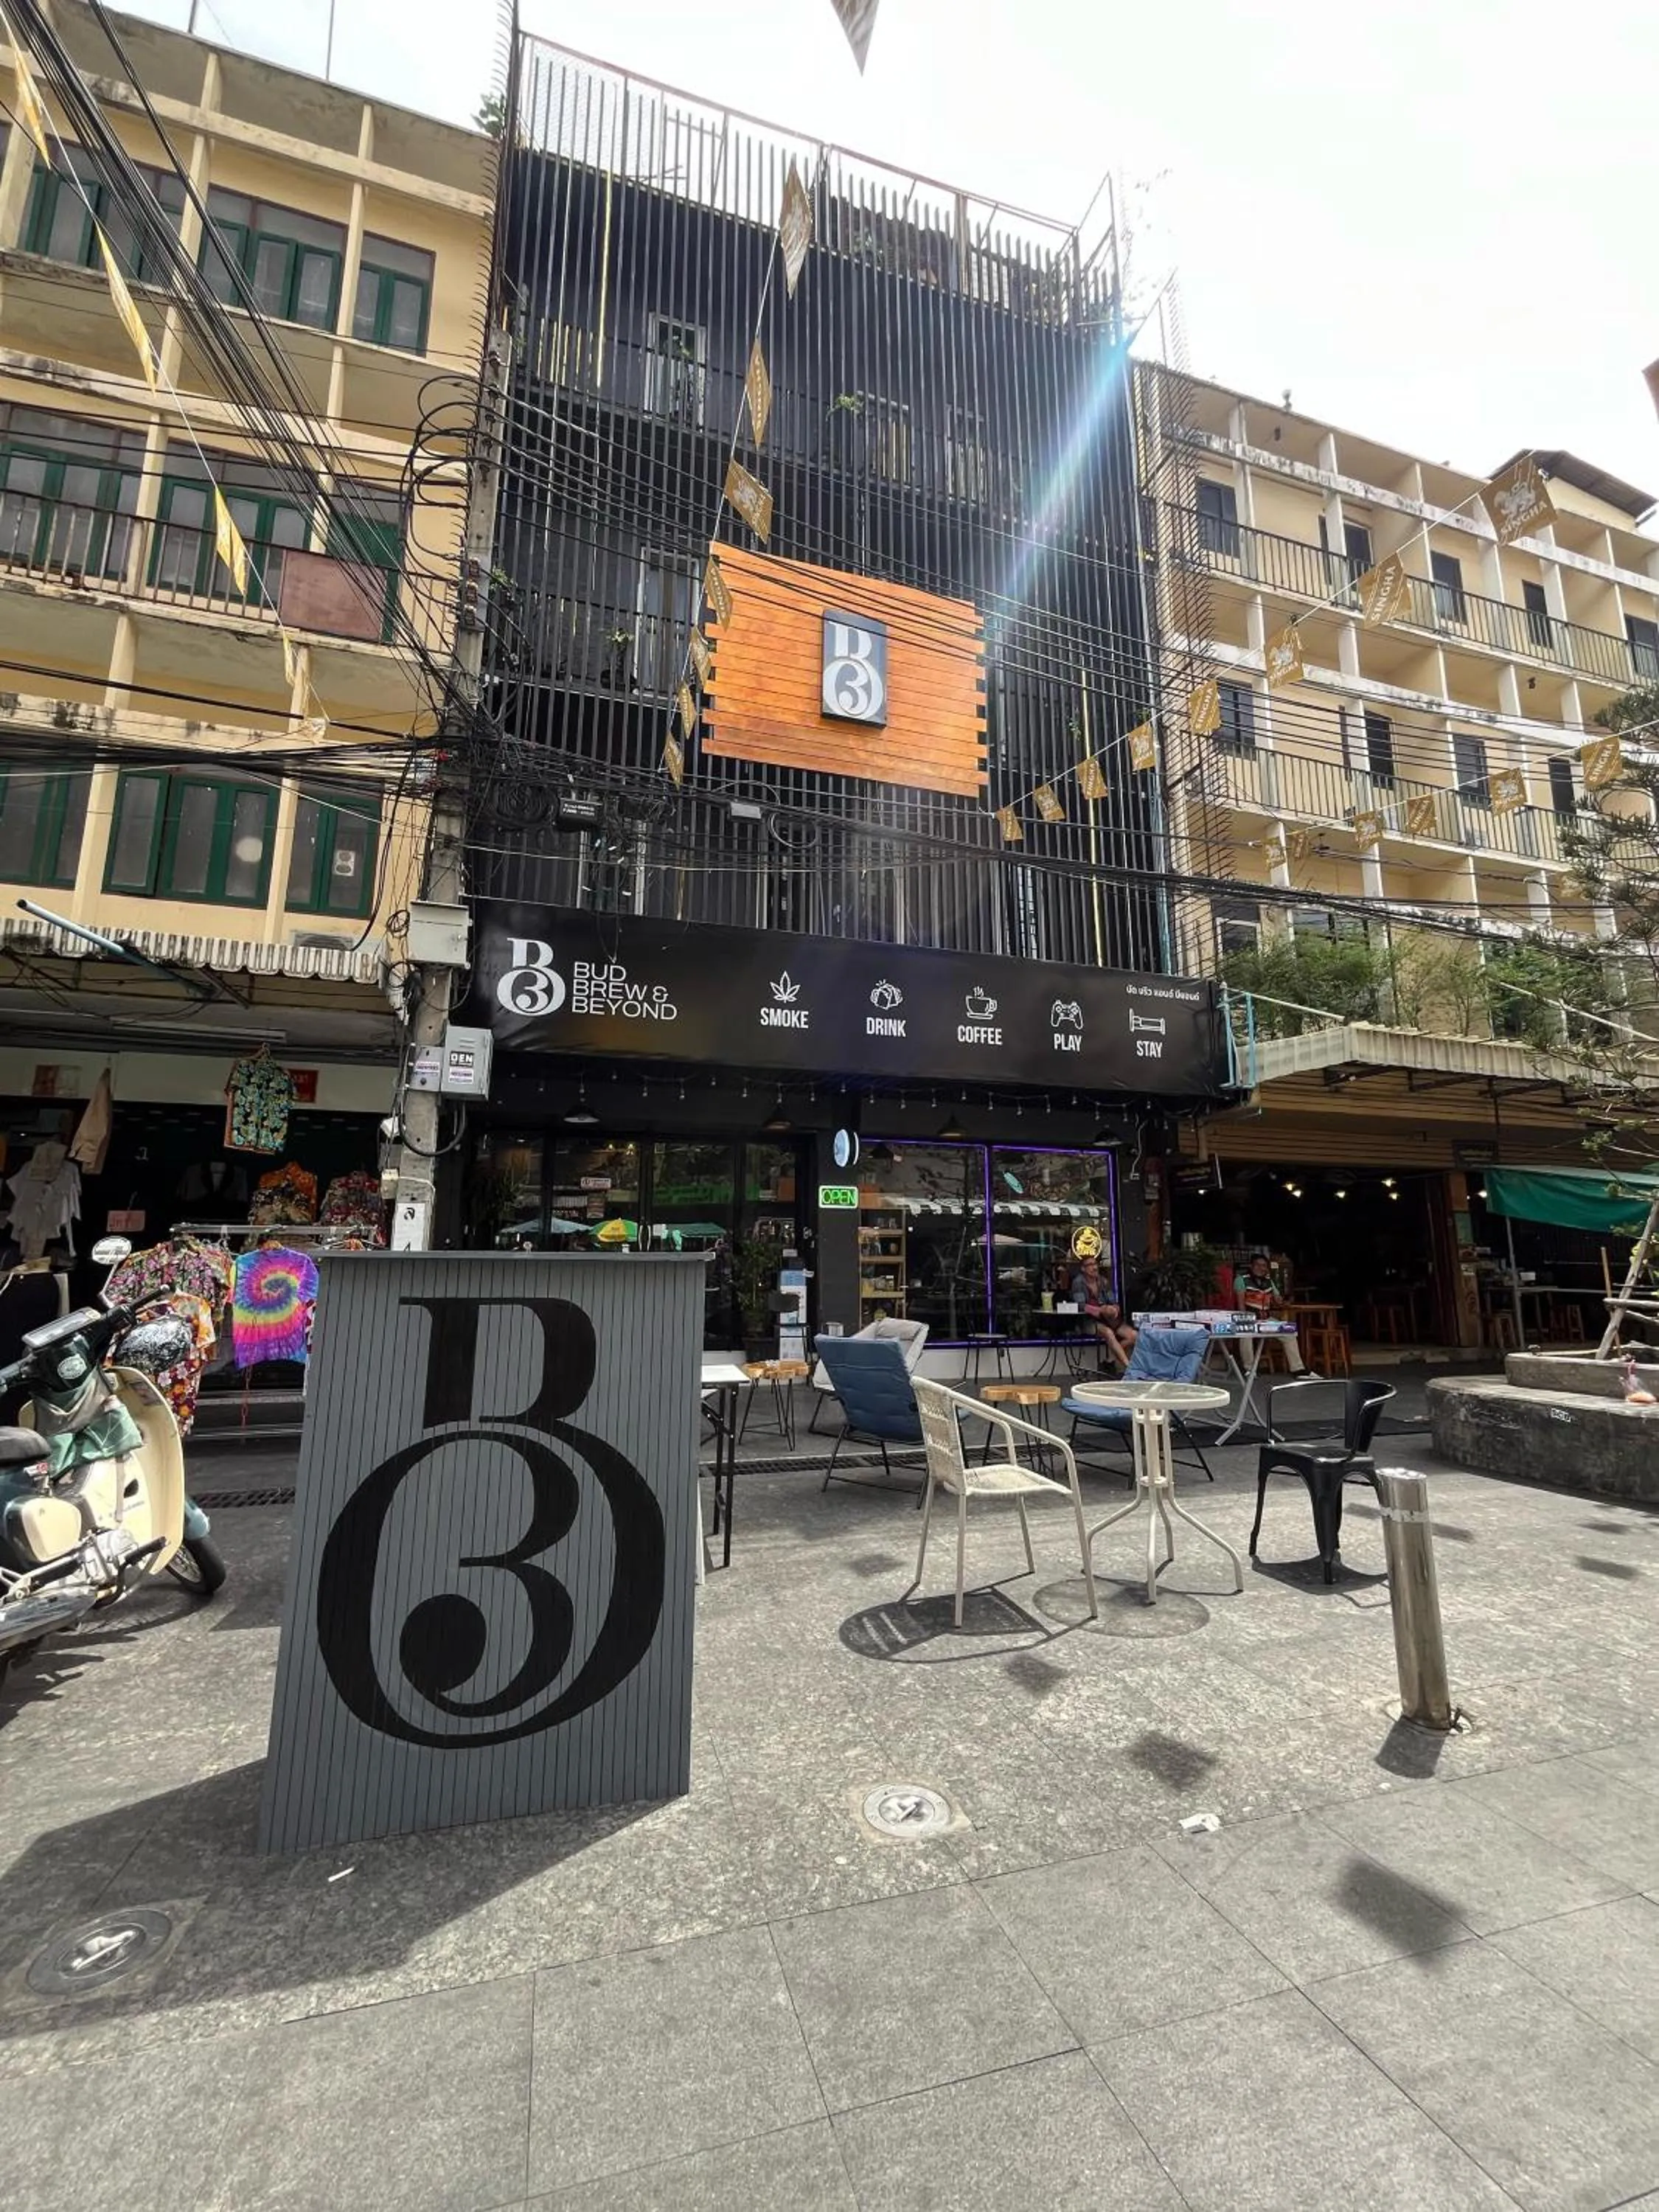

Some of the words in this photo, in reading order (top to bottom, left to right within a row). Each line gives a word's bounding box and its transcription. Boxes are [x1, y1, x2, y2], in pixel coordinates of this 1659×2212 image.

[1500, 501, 1548, 534] SINGHA
[1371, 566, 1396, 622] SINGHA
[574, 961, 627, 981] BUD
[573, 978, 647, 1001] BREW
[652, 986, 669, 1003] &
[571, 996, 678, 1020] BEYOND
[760, 1007, 809, 1029] SMOKE
[866, 1017, 906, 1037] DRINK
[958, 1025, 1003, 1046] COFFEE
[1054, 1033, 1082, 1052] PLAY
[1136, 1040, 1163, 1058] STAY
[822, 1189, 856, 1204] OPEN
